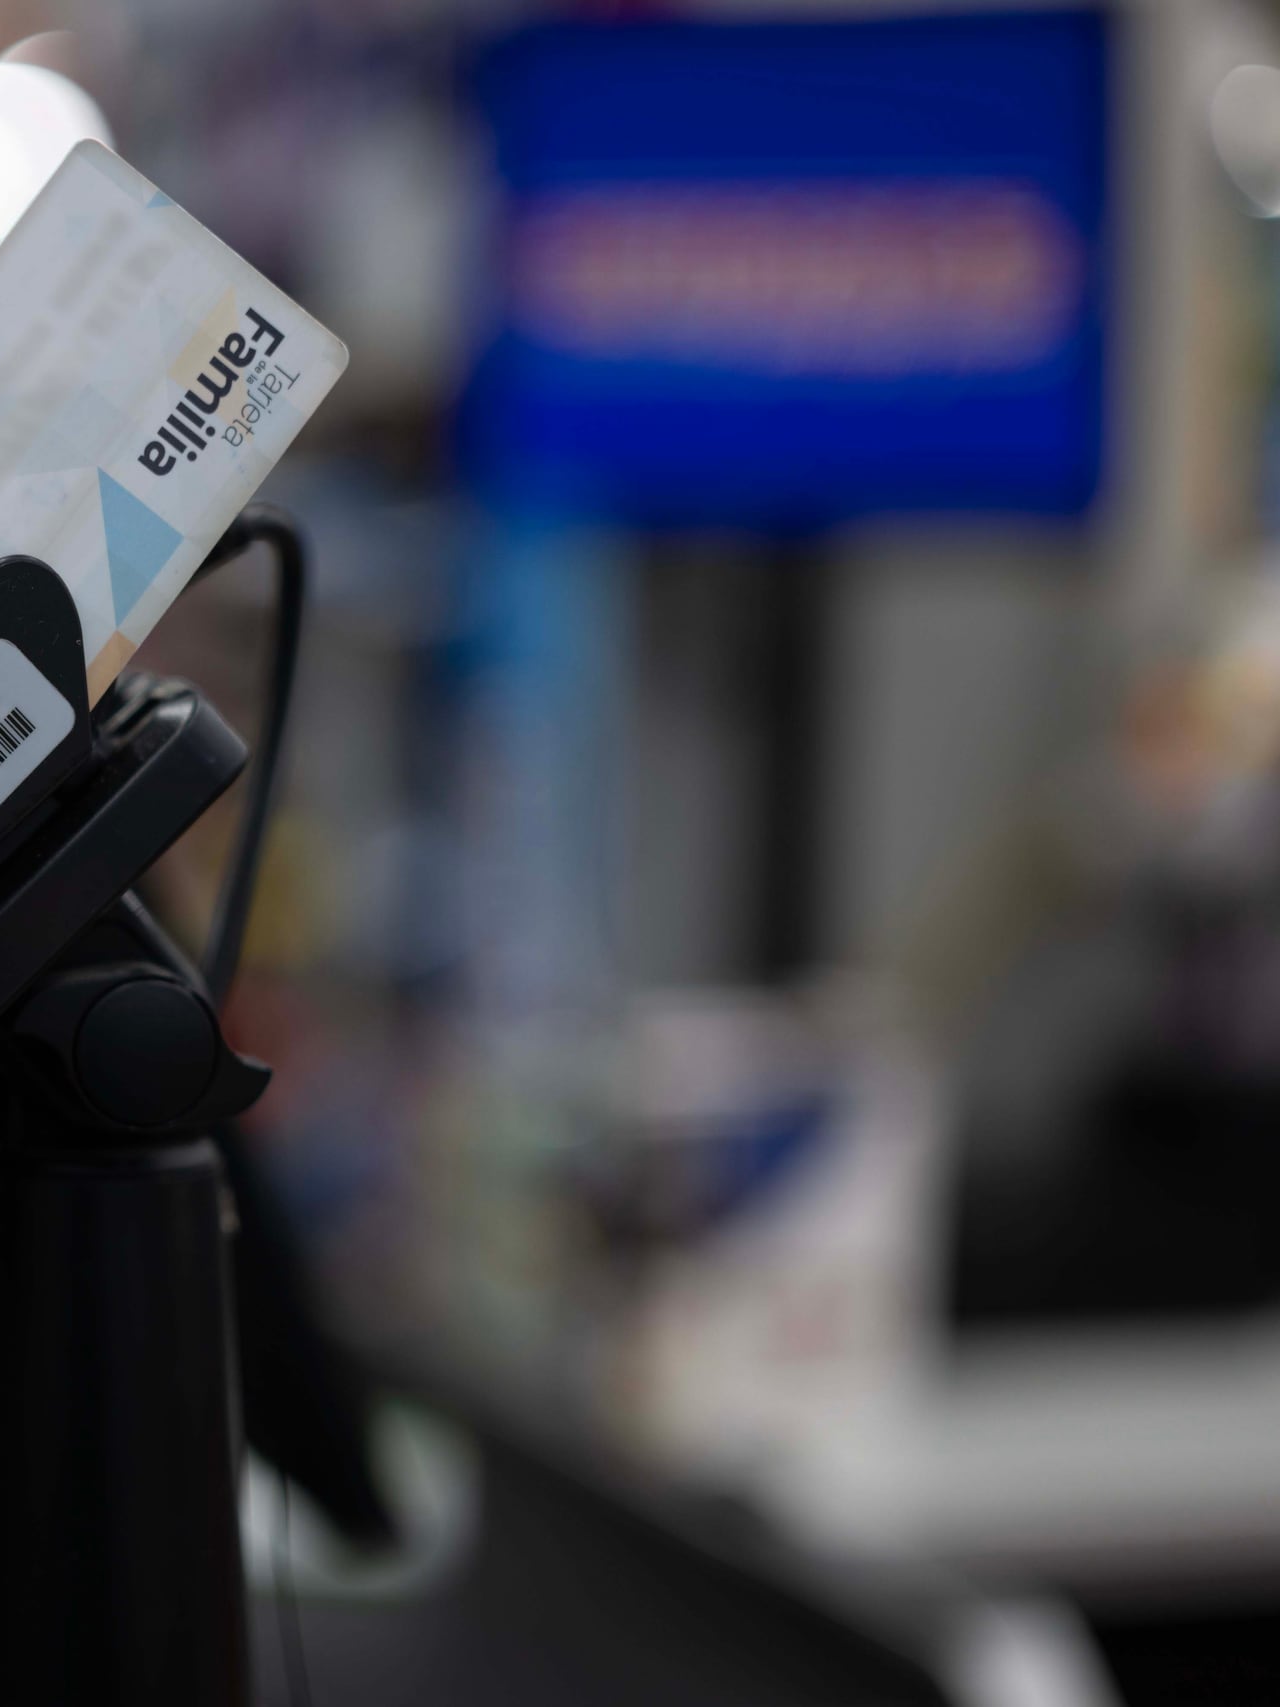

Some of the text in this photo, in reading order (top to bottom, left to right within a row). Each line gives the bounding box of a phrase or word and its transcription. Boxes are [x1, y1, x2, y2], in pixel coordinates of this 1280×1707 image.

[138, 307, 285, 476] Familia
[222, 364, 301, 447] Tarjeta
[246, 361, 267, 385] de la
